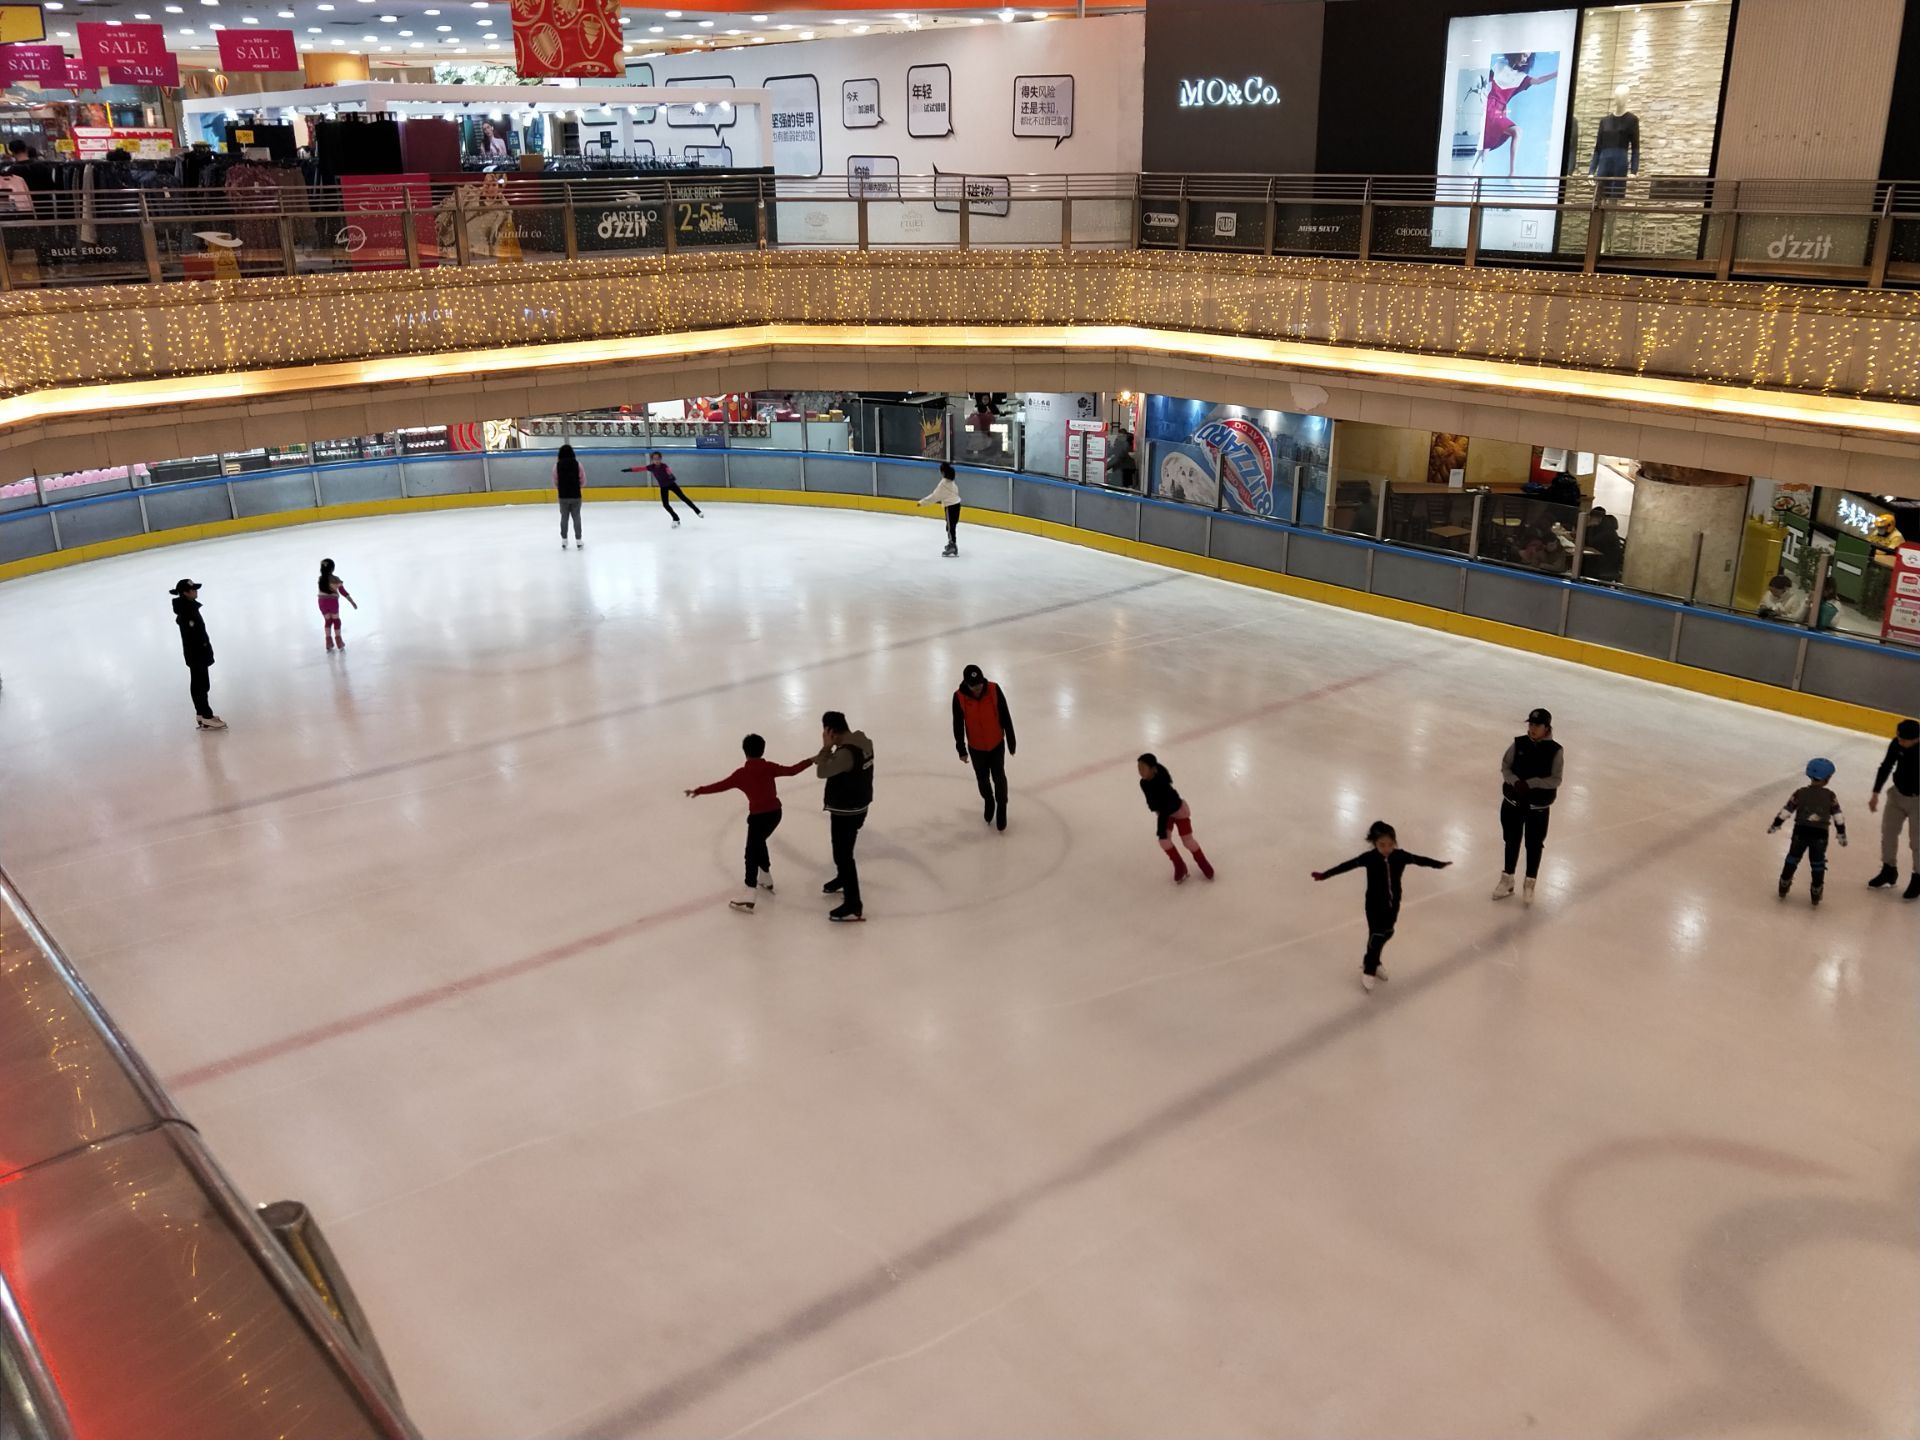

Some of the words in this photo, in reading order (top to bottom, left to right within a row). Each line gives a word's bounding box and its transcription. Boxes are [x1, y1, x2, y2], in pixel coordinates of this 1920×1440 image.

[98, 41, 149, 55] SALE
[236, 46, 281, 59] SALE
[8, 59, 51, 71] SALE
[123, 66, 165, 77] SALE
[846, 91, 859, 102] 今天
[911, 83, 933, 100] 年轻
[1021, 85, 1056, 98] 得失风险
[1179, 77, 1281, 107] MO&Co.
[1318, 225, 1341, 233] SIXTY
[51, 247, 77, 257] BLUE
[81, 245, 117, 256] ERDOS
[1258, 441, 1271, 470] ONLY
